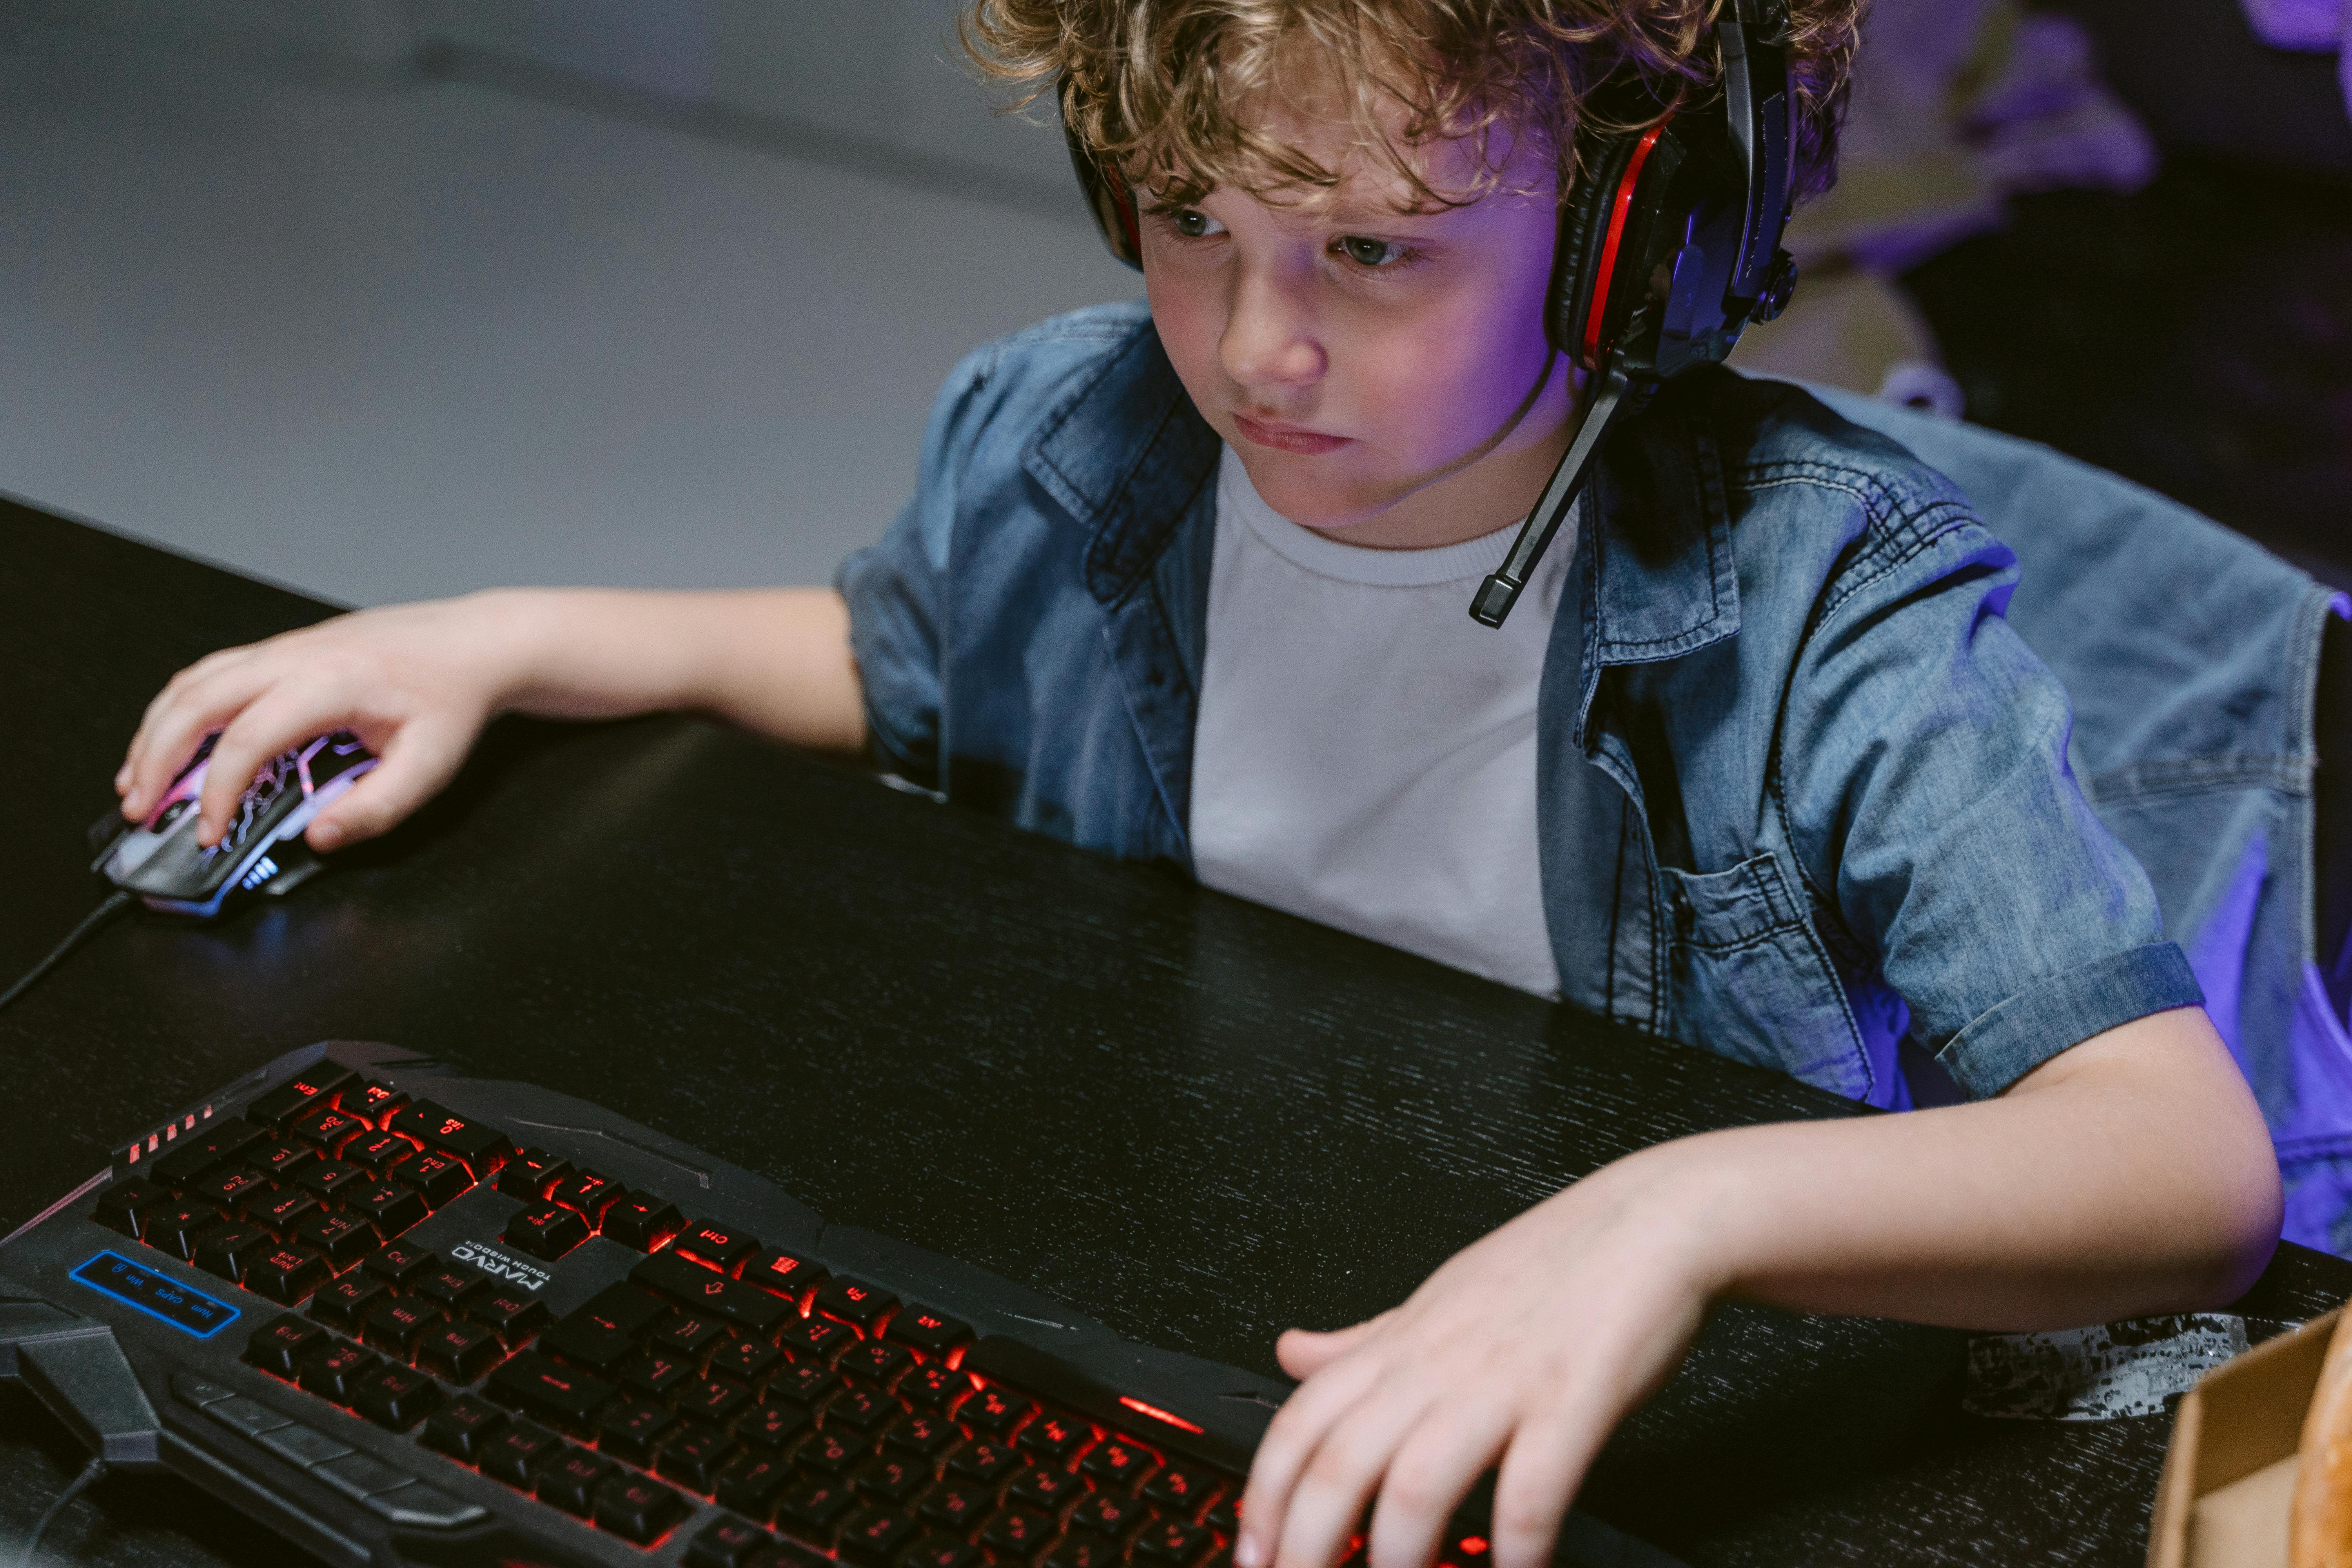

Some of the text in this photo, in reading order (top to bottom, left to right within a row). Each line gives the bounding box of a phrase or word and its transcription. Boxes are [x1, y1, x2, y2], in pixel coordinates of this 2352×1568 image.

[319, 1122, 332, 1131] 3
[325, 1116, 344, 1126] PD
[439, 1125, 453, 1134] 0
[272, 1153, 285, 1161] 6
[422, 1157, 445, 1169] End
[323, 1172, 337, 1180] 5
[223, 1182, 236, 1191] 9
[699, 1229, 729, 1245] Ctrl
[278, 1251, 303, 1265] Lock
[387, 1251, 410, 1263] PD
[465, 1240, 551, 1281] TOUGH WISDOM
[270, 1257, 294, 1270] Num
[452, 1247, 544, 1290] MARVO
[126, 1274, 213, 1318] Num CAPS Win
[338, 1284, 362, 1297] PU
[846, 1287, 867, 1301] Fn
